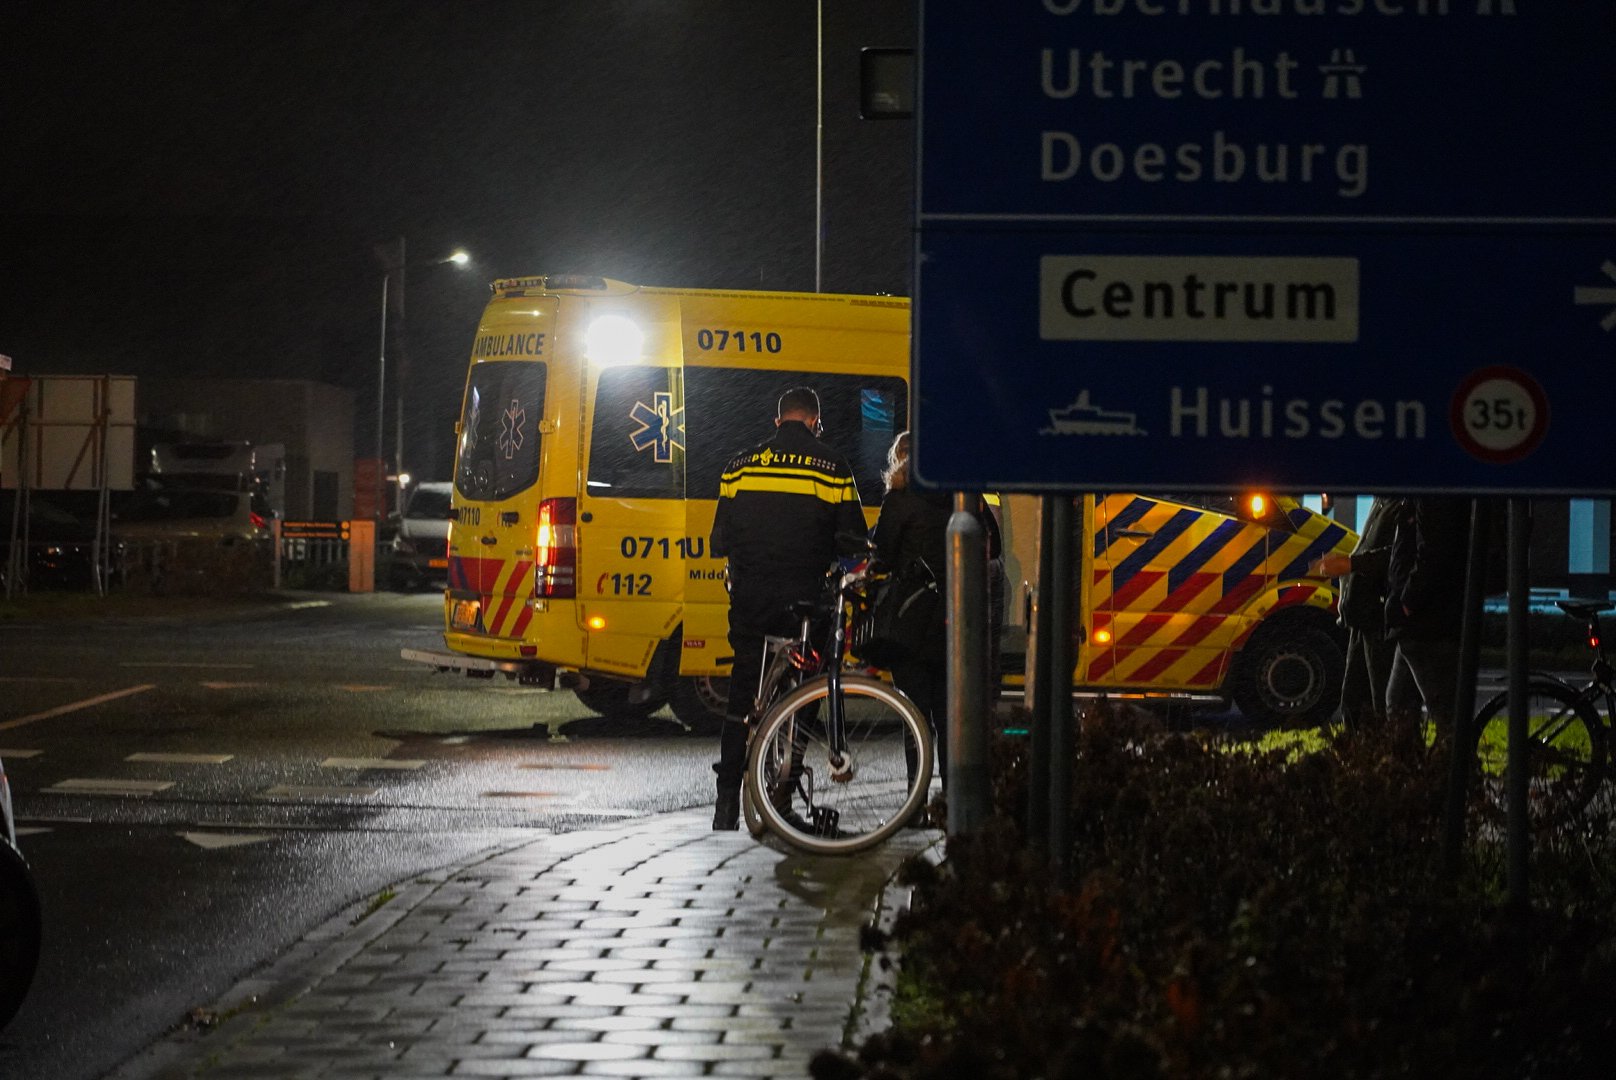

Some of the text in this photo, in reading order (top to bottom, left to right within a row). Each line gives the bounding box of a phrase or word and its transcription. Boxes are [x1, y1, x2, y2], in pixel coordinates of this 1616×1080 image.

[1041, 47, 1298, 99] Utrecht
[1041, 130, 1369, 198] Doesburg
[1060, 269, 1337, 320] Centrum
[475, 333, 546, 357] AMBULANCE
[697, 328, 782, 354] 07110
[1170, 384, 1427, 438] Huissen
[1470, 399, 1528, 431] 35t
[752, 448, 814, 466] POLITIE
[459, 506, 481, 526] 07110
